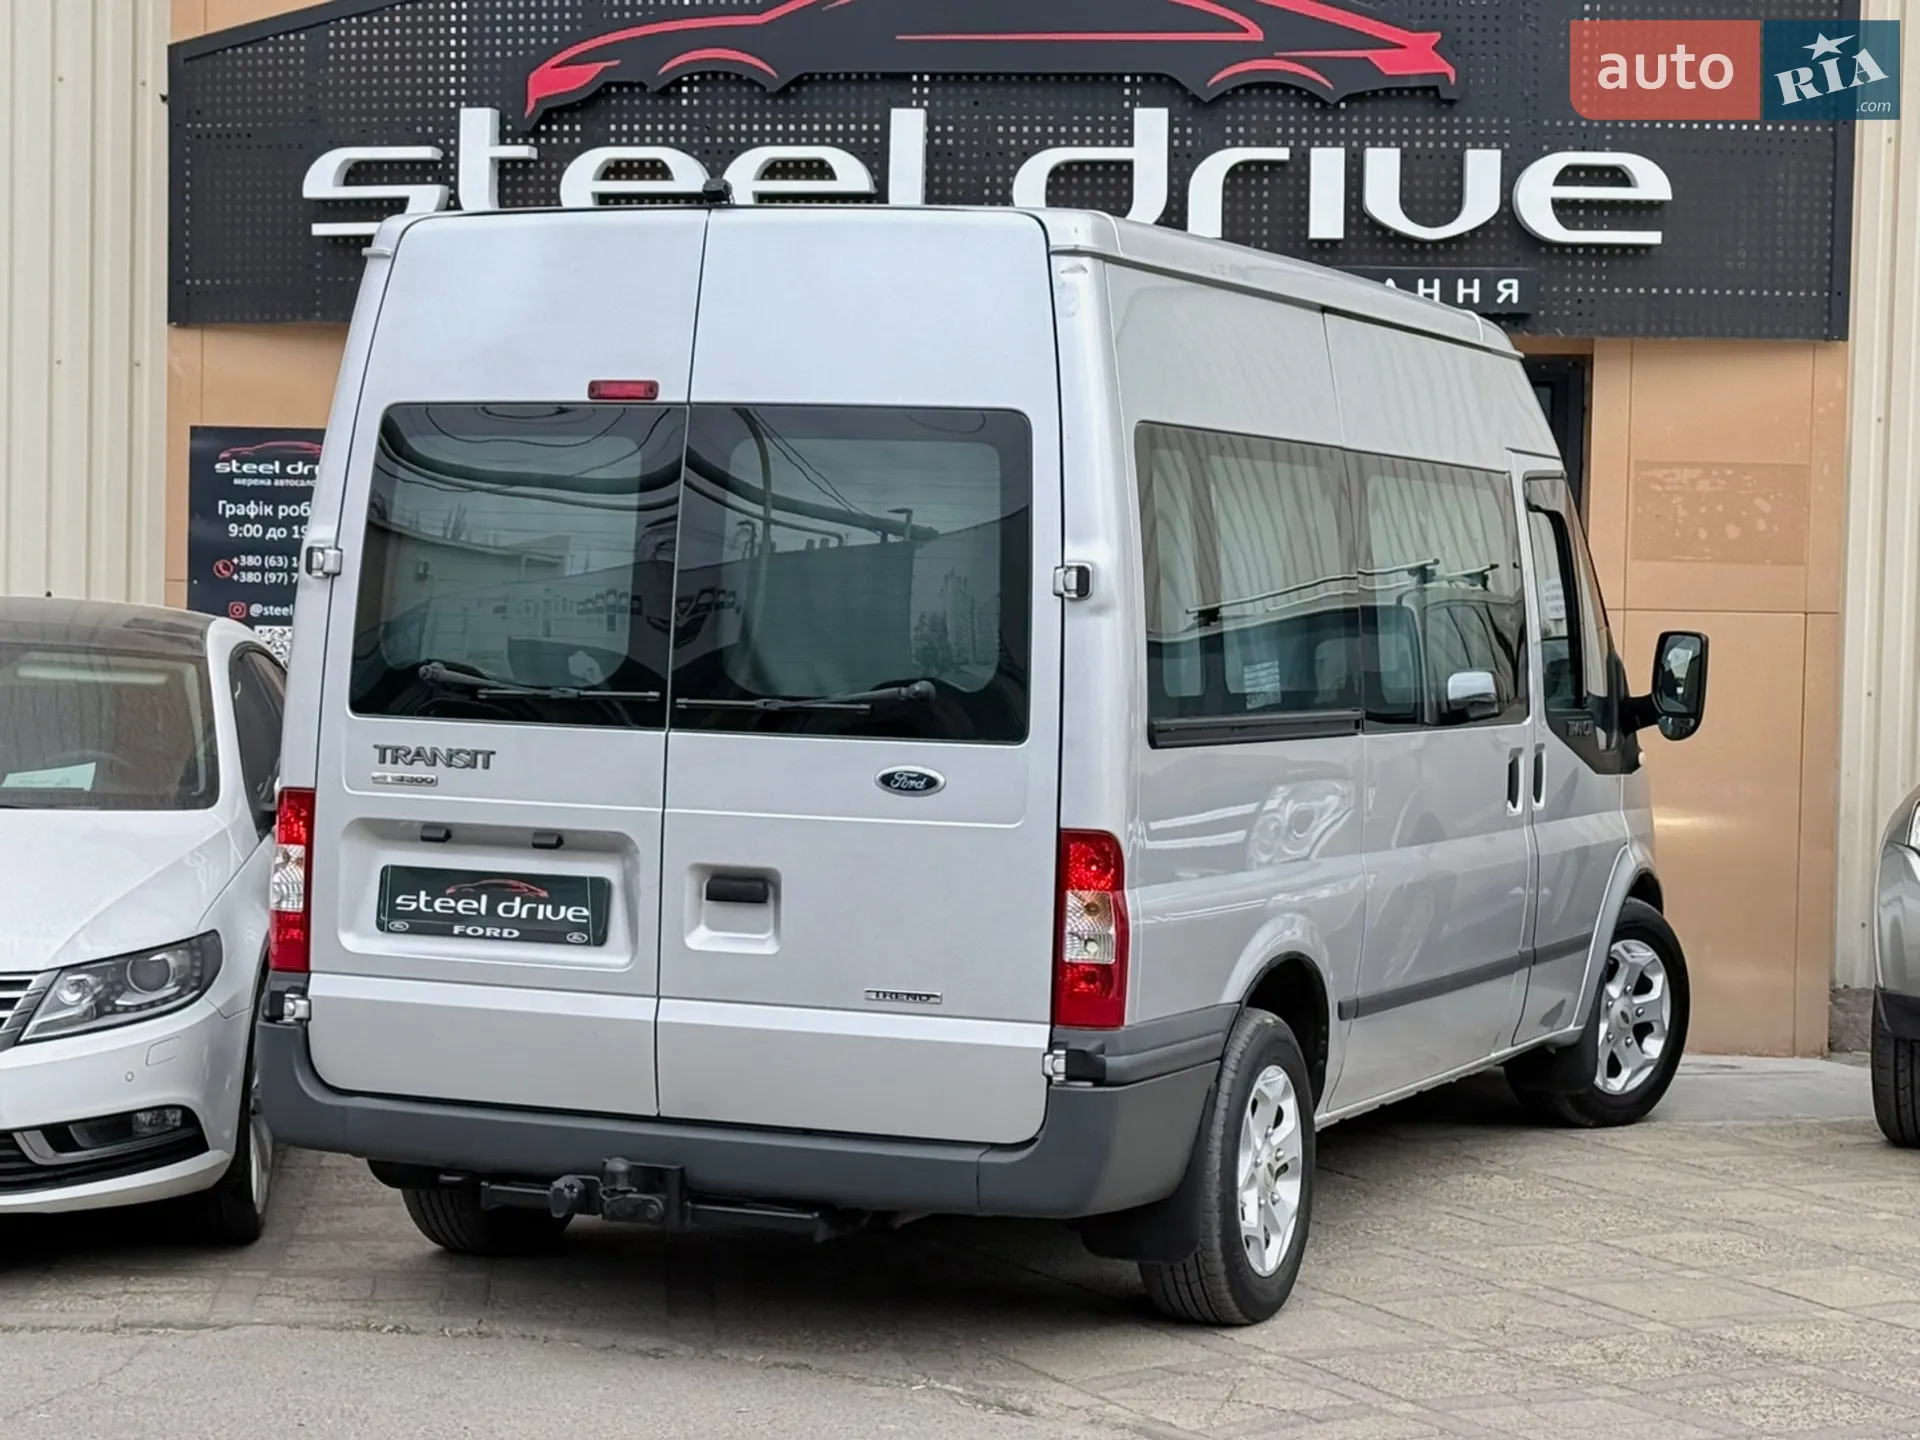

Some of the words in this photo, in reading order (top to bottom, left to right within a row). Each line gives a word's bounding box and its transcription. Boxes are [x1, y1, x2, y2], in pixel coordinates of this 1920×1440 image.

[302, 107, 927, 237] steel
[1012, 107, 1673, 246] drive
[1385, 277, 1520, 305] ННЯ
[214, 459, 280, 475] steel
[286, 460, 320, 475] dri
[217, 499, 273, 519] Графік
[278, 501, 311, 520] роб
[228, 523, 263, 538] 9:00
[265, 527, 287, 541] до
[232, 555, 262, 567] +380
[264, 555, 288, 569] (63)
[232, 572, 262, 584] +380
[264, 572, 288, 586] (97)
[249, 603, 293, 617] @steel
[373, 743, 497, 771] TRANSIT
[890, 770, 926, 789] Ford
[395, 890, 487, 917] steel
[497, 896, 590, 923] drive
[452, 924, 521, 939] FORD
[874, 991, 932, 1004] TREND
